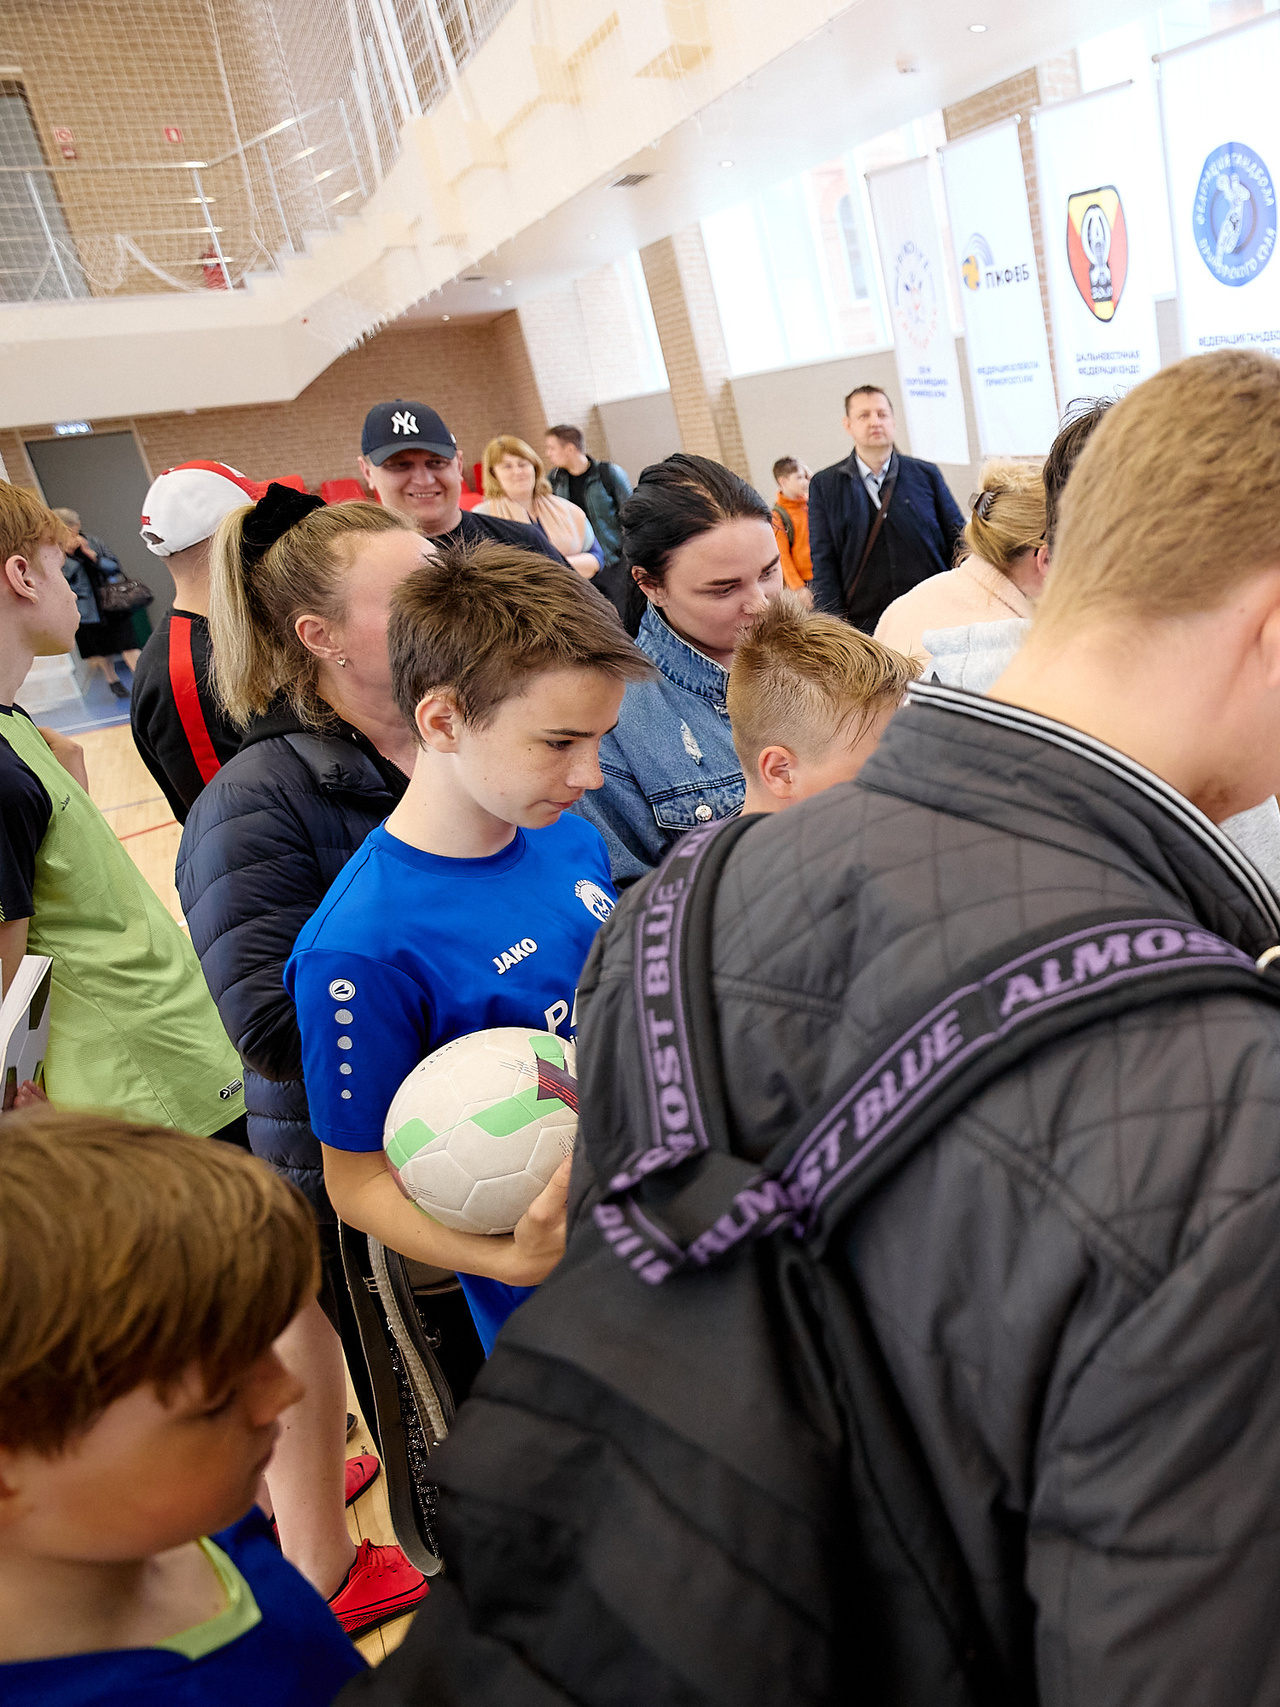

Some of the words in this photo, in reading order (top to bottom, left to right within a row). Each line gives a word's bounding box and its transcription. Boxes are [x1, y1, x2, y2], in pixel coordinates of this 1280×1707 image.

[391, 410, 420, 436] NY
[491, 937, 539, 976] JAKO
[643, 876, 684, 998] BLUE
[854, 1009, 964, 1141] BLUE
